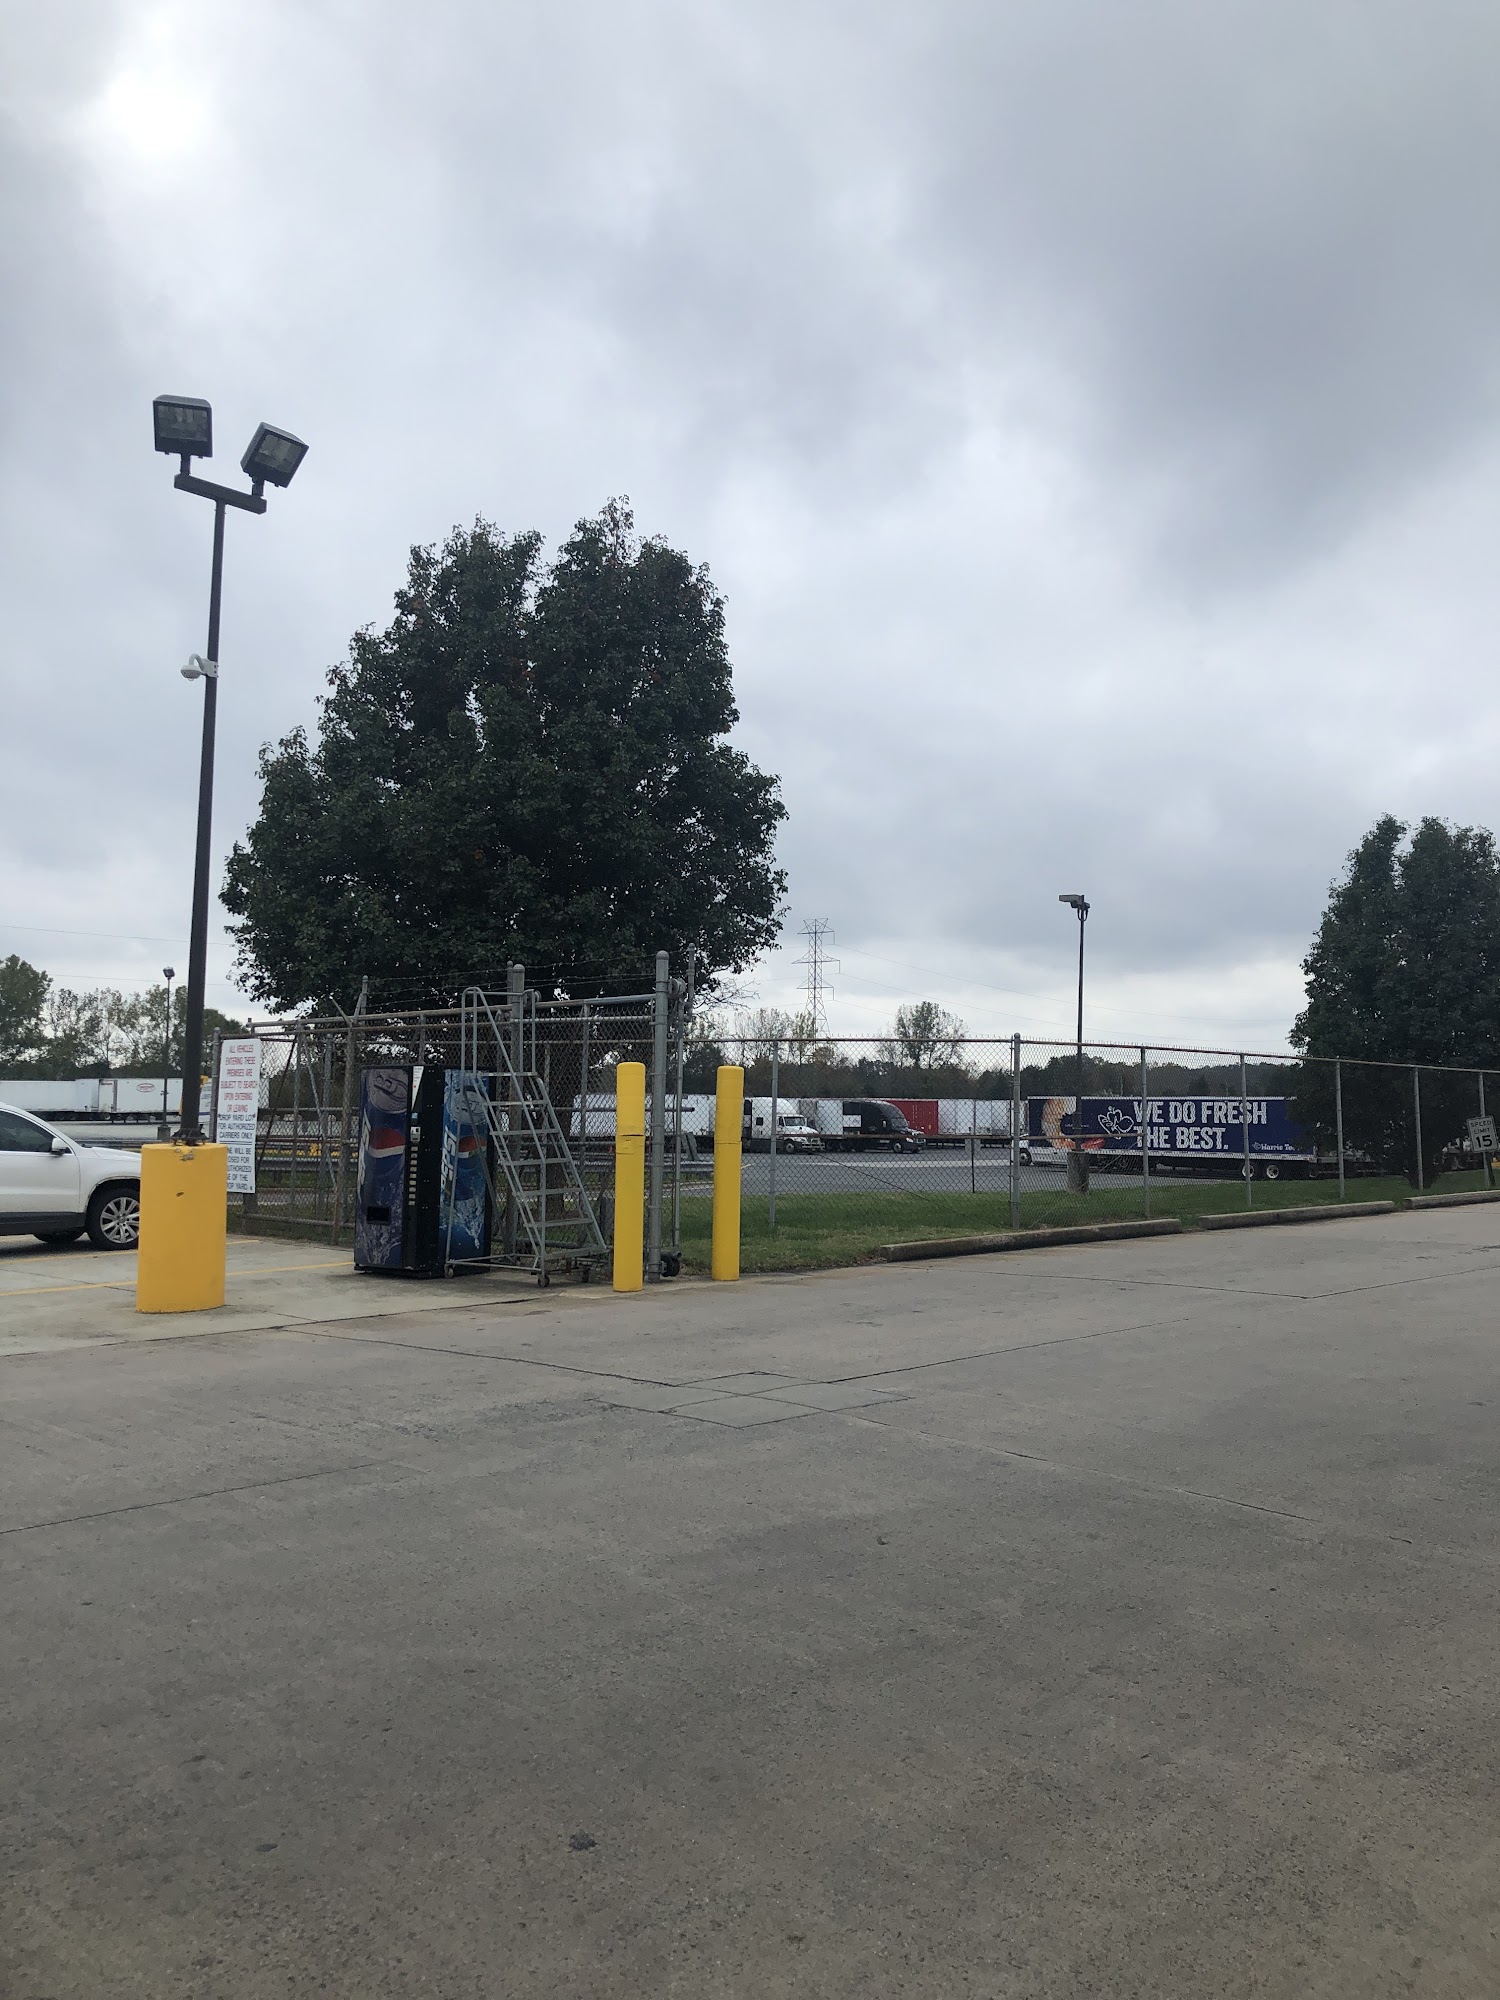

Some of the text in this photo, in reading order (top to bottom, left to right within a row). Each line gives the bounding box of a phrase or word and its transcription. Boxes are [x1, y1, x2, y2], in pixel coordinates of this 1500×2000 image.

[226, 1056, 256, 1065] ENTERING THESE
[227, 1068, 245, 1077] PREMISES
[220, 1080, 257, 1089] SUBJECT TO SEARCH
[224, 1092, 253, 1101] UPON ENTERING
[227, 1104, 249, 1113] OR LEAVING
[1133, 1101, 1268, 1125] WE DO FRESH
[232, 1114, 244, 1122] YARD
[218, 1122, 256, 1131] FOR AUTHORIZED
[219, 1131, 253, 1140] CARRIERS ONLY
[1133, 1126, 1229, 1149] THE BEST.
[1475, 1135, 1493, 1148] 15
[234, 1147, 245, 1155] WILL
[245, 1147, 252, 1155] BE
[227, 1155, 250, 1164] OSED FOR
[227, 1164, 252, 1172] UTHORIZED
[232, 1173, 238, 1181] OF
[239, 1173, 249, 1182] THE
